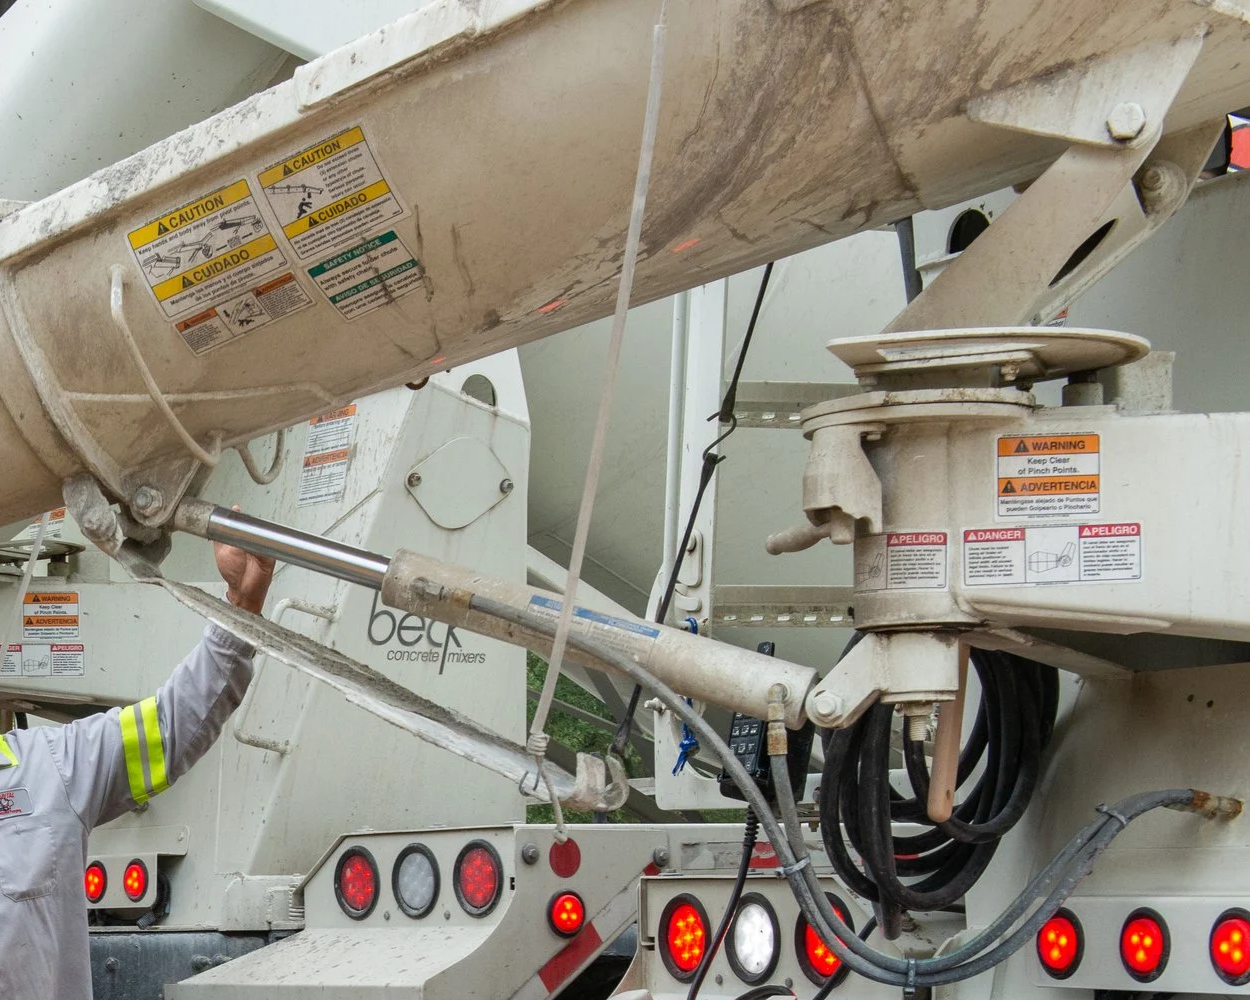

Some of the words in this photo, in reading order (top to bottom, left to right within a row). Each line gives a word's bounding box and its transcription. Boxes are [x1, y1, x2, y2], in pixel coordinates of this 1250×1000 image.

[291, 139, 341, 170] CAUTION
[167, 194, 225, 229] CAUTION
[316, 191, 368, 222] CUIDADO
[137, 245, 152, 255] Keep
[151, 237, 168, 249] hands
[167, 233, 179, 241] and
[178, 226, 193, 237] body
[191, 220, 206, 231] away
[206, 213, 219, 223] from
[218, 207, 233, 217] pivot
[191, 247, 251, 282] CUIDADO
[318, 272, 341, 286] Always
[340, 262, 362, 275] secure
[378, 245, 398, 257] chute
[322, 252, 354, 270] SAFETY
[351, 238, 382, 256] NOTICE
[169, 290, 195, 306] Mantenga
[231, 265, 251, 278] cuerpo
[323, 282, 338, 291] with
[336, 273, 356, 285] safety
[333, 287, 358, 302] AVISO
[357, 281, 371, 291] DE
[368, 261, 413, 285] SEURIDAD
[1031, 439, 1085, 451] WARNING
[1027, 457, 1046, 465] Keep
[1049, 455, 1070, 464] Clear
[1052, 465, 1079, 474] Points.
[1020, 479, 1097, 493] ADVERTENCIA
[899, 534, 944, 544] PELIGRO
[977, 530, 1021, 541] DANGER
[1092, 525, 1138, 536] PELIGRO
[387, 650, 439, 661] concrete
[447, 650, 486, 663] mixers
